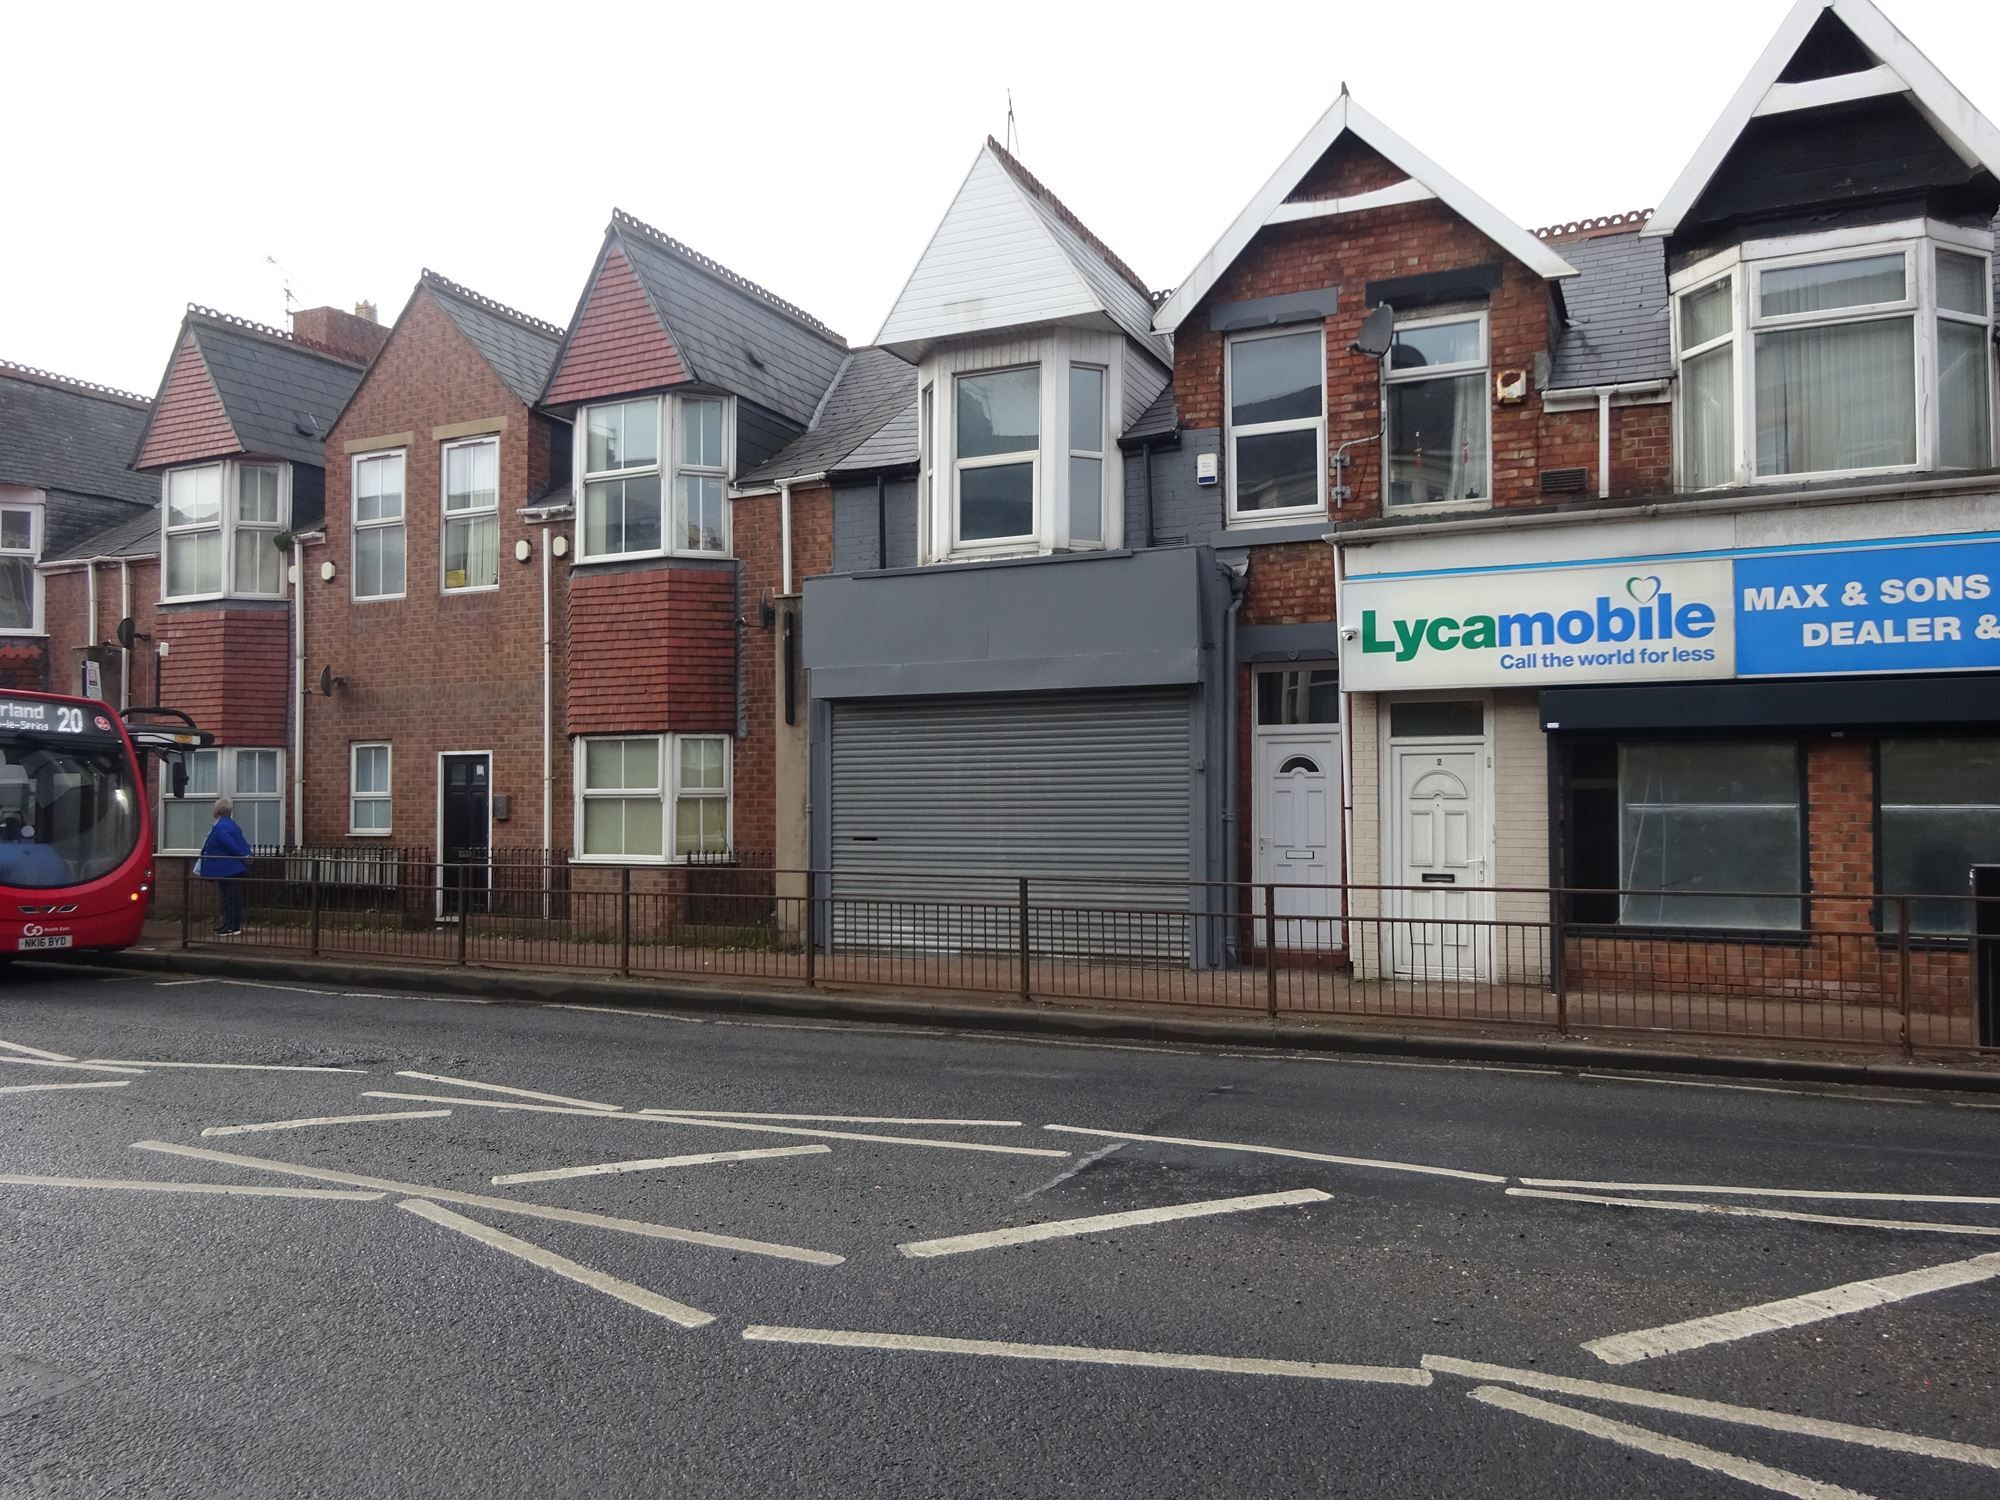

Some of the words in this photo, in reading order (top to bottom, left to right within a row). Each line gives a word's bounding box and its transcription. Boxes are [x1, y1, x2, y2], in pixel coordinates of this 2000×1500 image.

[1743, 583, 1829, 611] MAX
[1841, 581, 1868, 606] &
[1880, 574, 1991, 604] SONS
[1362, 590, 1716, 662] Lycamobile
[1802, 616, 1962, 647] DEALER
[1975, 614, 2000, 640] &
[1500, 653, 1537, 669] Call
[1541, 652, 1574, 667] the
[1578, 649, 1635, 666] world
[1640, 648, 1669, 663] for
[1673, 647, 1715, 662] less
[57, 707, 83, 733] 20
